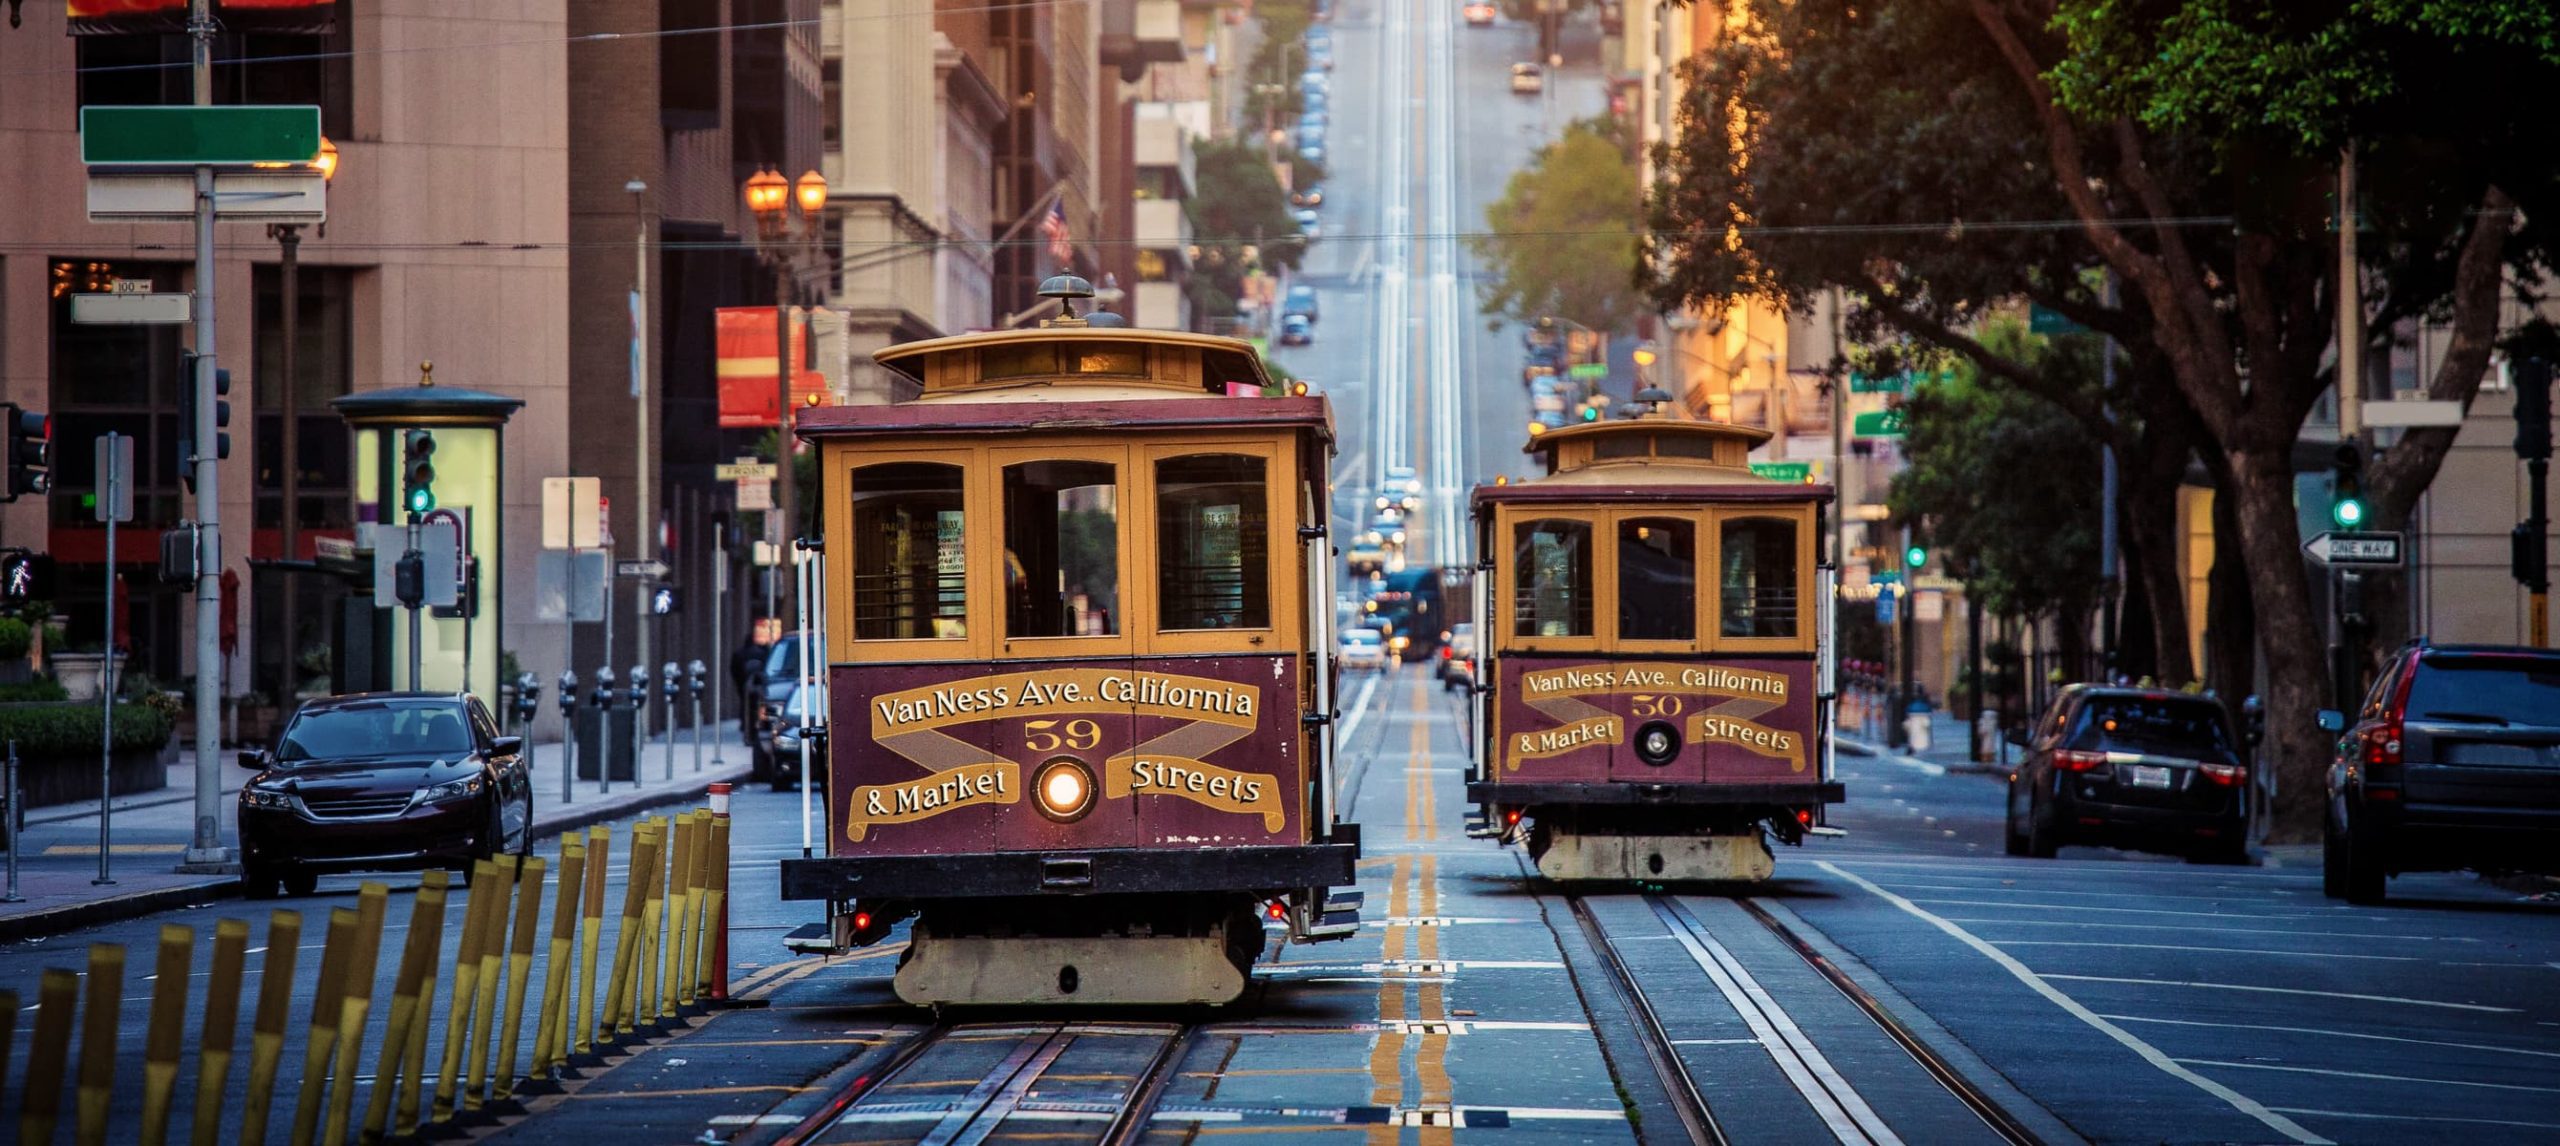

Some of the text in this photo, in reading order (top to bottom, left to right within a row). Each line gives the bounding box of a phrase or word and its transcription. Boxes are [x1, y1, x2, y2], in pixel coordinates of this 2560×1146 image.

[118, 283, 135, 292] 100
[2330, 541, 2390, 556] ONE WAY
[1528, 674, 1563, 694] Van
[1566, 671, 1616, 690] Ness
[1681, 668, 1785, 695] California
[878, 698, 933, 726] Van
[934, 686, 1010, 717] Ness
[1099, 676, 1253, 717] California
[1631, 694, 1683, 717] 50
[1024, 719, 1102, 752] 59
[1520, 720, 1614, 752] & Market
[1703, 717, 1792, 751] Streets
[865, 769, 1006, 818] & Market
[1132, 760, 1262, 803] Streets
